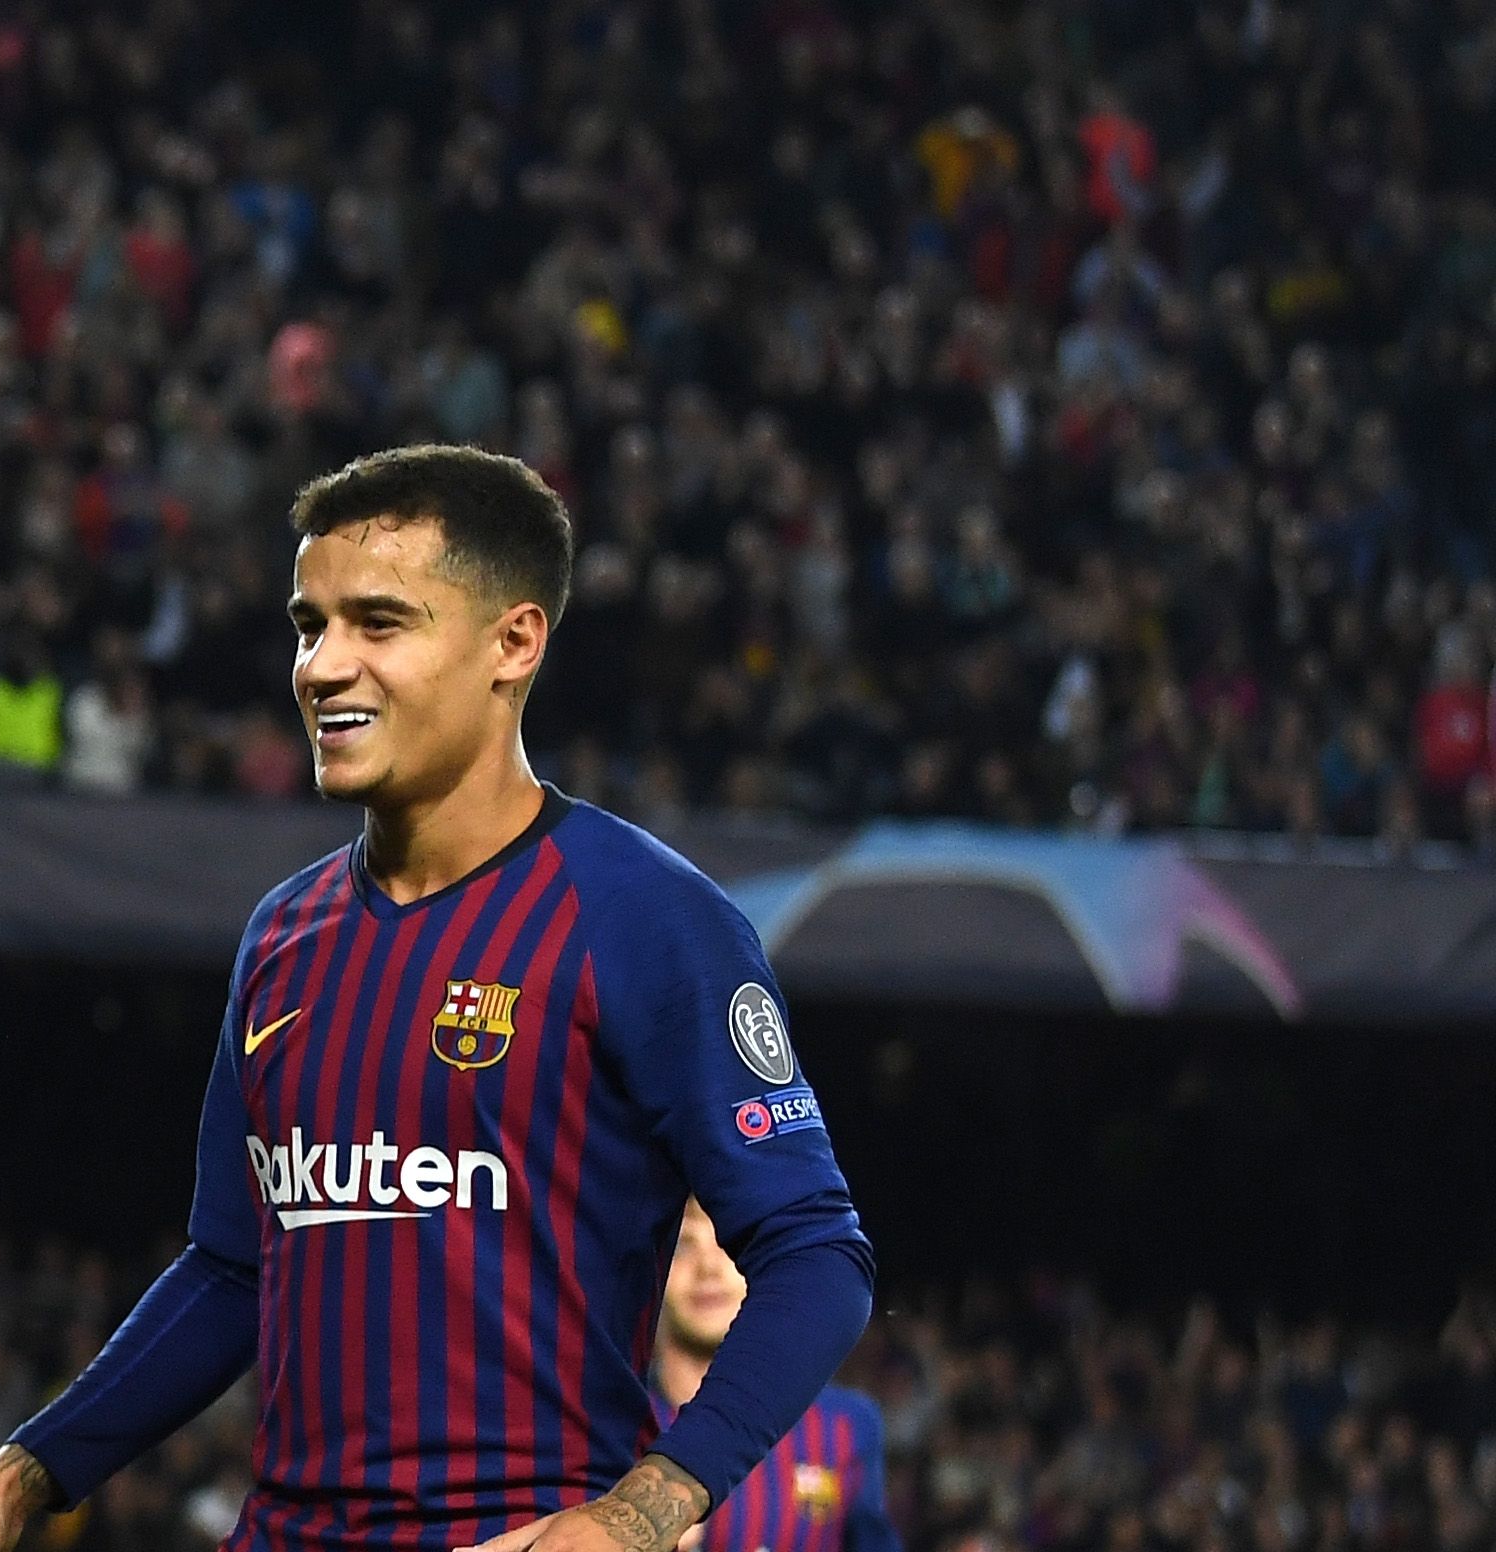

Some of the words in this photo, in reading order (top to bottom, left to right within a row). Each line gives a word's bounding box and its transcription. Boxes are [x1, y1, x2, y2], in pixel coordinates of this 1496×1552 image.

[458, 1016, 488, 1030] FCB
[762, 1031, 778, 1058] 5
[771, 1097, 823, 1124] RESPE
[246, 1126, 508, 1211] Rakuten
